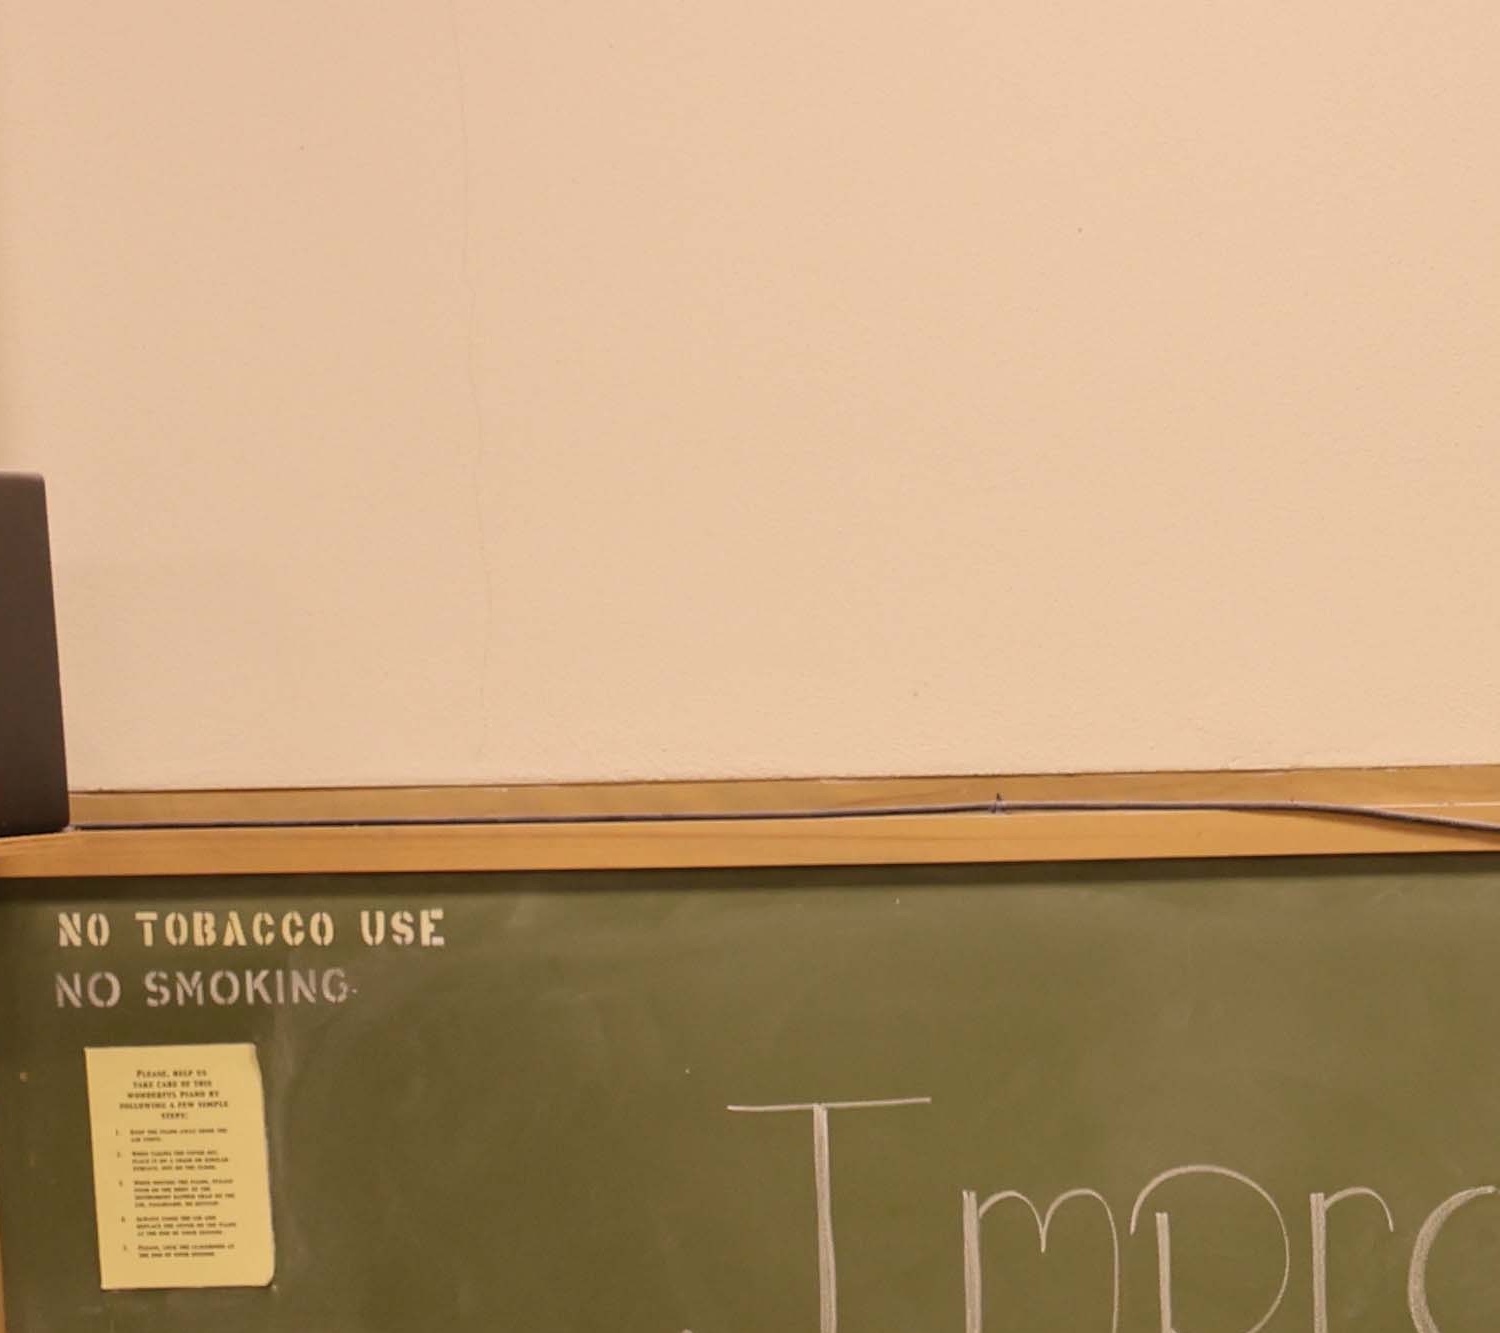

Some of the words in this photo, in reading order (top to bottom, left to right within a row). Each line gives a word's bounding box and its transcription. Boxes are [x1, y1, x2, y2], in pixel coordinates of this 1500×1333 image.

[57, 911, 110, 948] NO
[135, 910, 335, 947] TOBACCO
[360, 908, 445, 947] USE
[56, 970, 122, 1008] NO
[144, 966, 350, 1008] SMOKING
